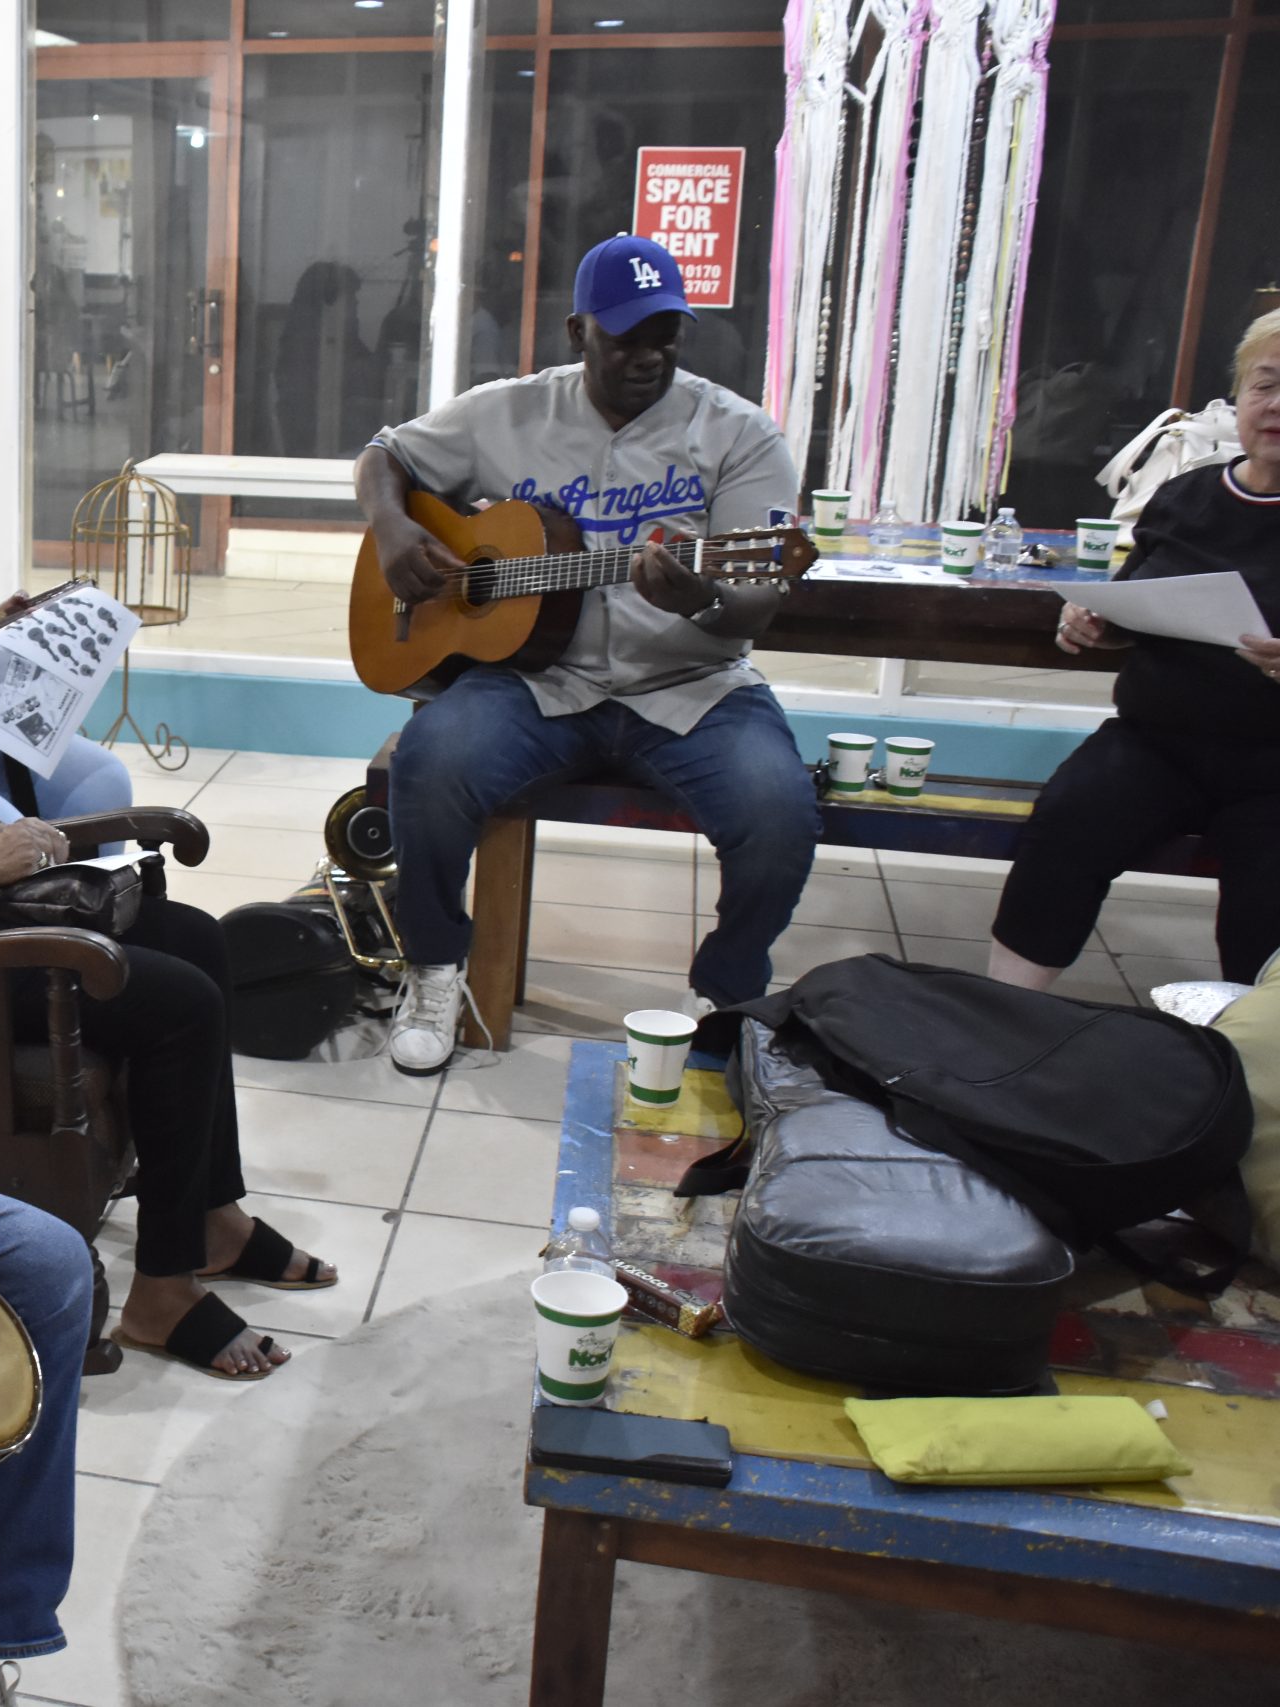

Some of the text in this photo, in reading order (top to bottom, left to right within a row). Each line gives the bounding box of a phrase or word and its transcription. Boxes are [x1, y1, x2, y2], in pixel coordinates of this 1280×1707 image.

[646, 164, 732, 177] COMMERCIAL
[645, 178, 731, 204] SPACE
[660, 205, 712, 230] FOR
[629, 257, 662, 289] LA
[559, 464, 705, 545] Angeles
